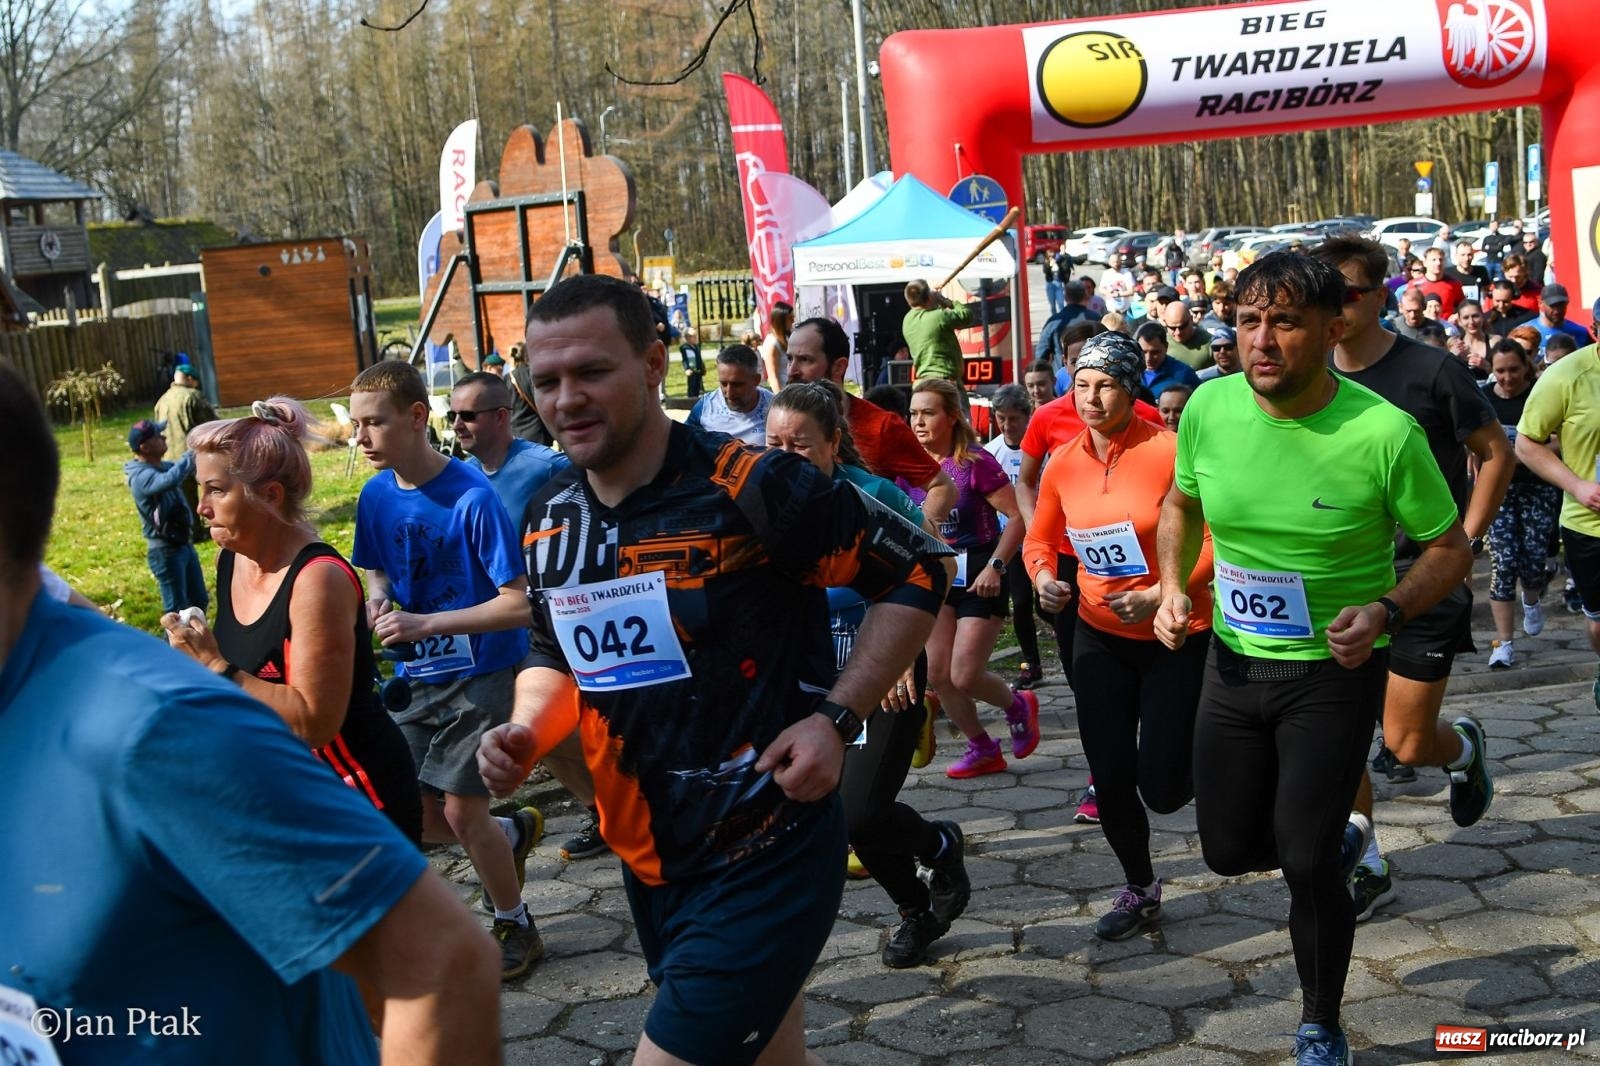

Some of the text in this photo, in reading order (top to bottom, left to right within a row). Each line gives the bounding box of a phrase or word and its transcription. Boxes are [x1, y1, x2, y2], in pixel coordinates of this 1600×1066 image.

[1240, 10, 1327, 35] BIEG
[1171, 36, 1407, 81] TWARDZIELA
[1195, 77, 1384, 118] RACIBÓRZ
[452, 149, 467, 231] RACI
[967, 361, 993, 380] 09
[1085, 543, 1127, 565] 013
[1247, 573, 1295, 584] TWARDZIELA
[567, 593, 589, 606] BIEG
[590, 581, 655, 602] TWARDZIELA
[1230, 589, 1290, 620] 062
[414, 635, 458, 660] 022
[573, 615, 656, 663] 042
